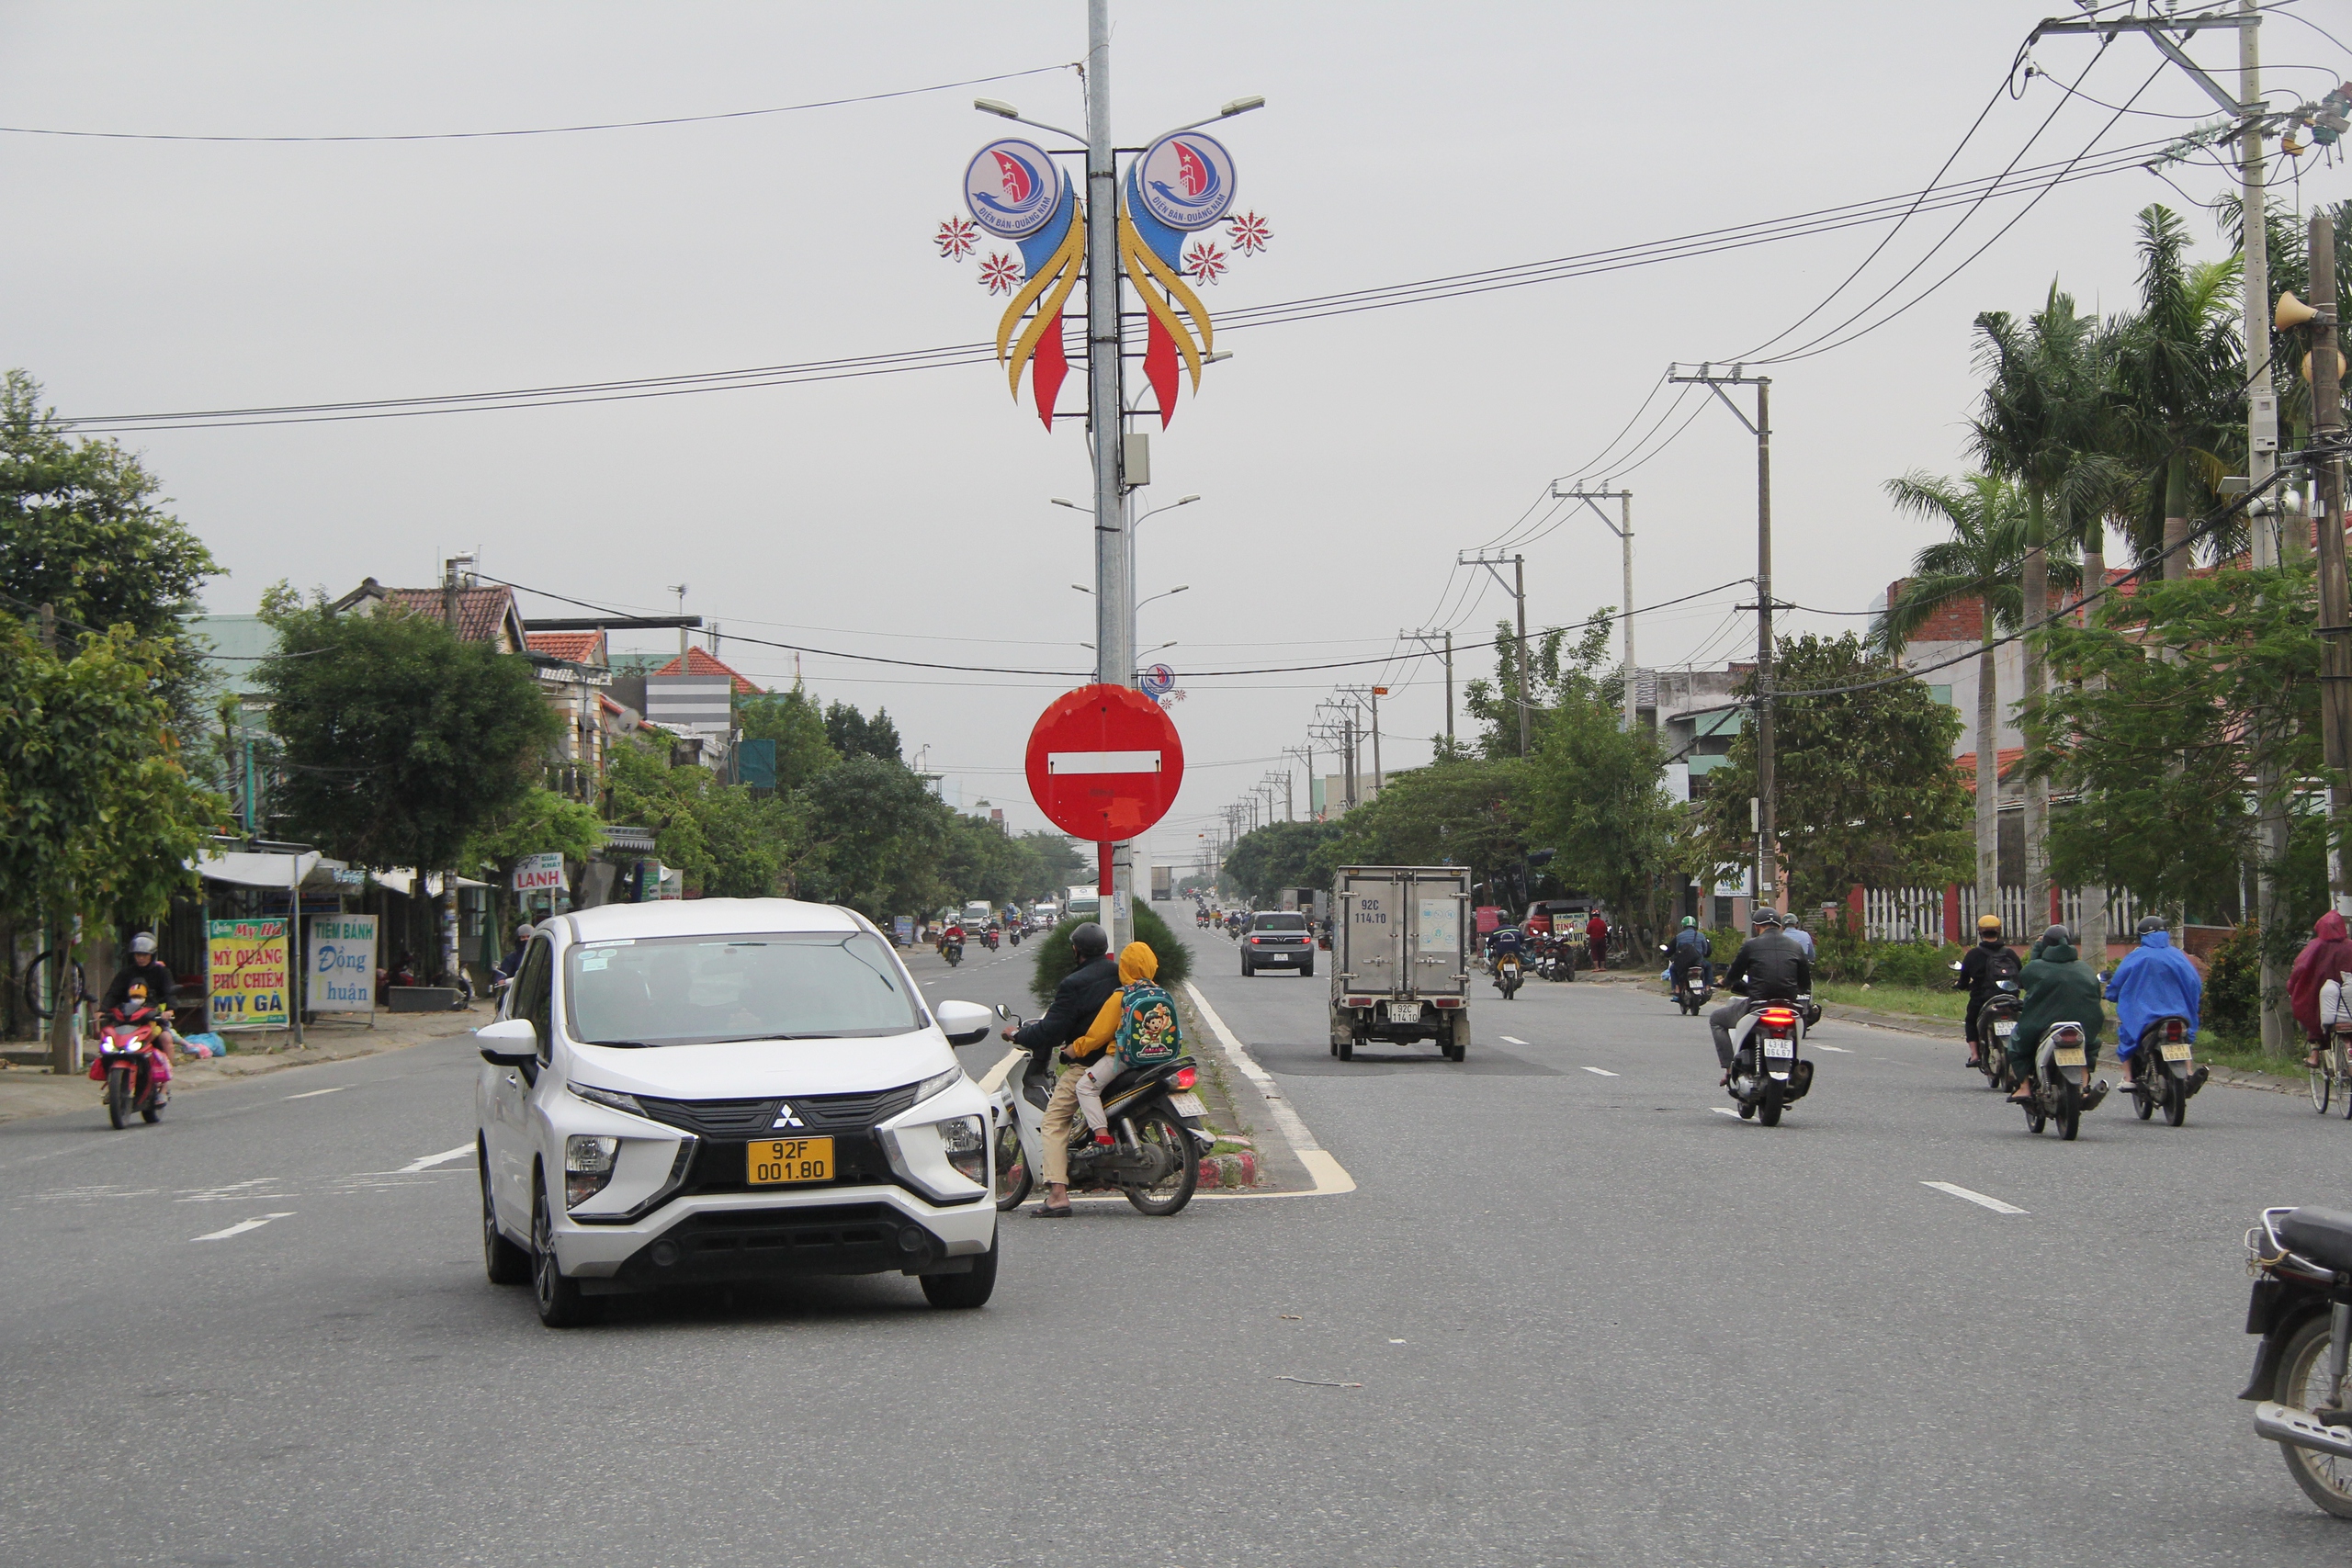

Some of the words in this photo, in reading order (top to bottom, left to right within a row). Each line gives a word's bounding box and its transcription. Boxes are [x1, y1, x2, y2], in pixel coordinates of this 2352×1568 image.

[1036, 197, 1051, 215] NAM
[1213, 193, 1227, 211] NAM
[517, 871, 559, 888] LANH
[1362, 899, 1379, 910] 92C
[1355, 912, 1386, 924] 114.10
[314, 918, 341, 943] TIỆM
[343, 918, 374, 940] BÁNH
[318, 945, 367, 973] Đồng
[254, 990, 283, 1011] GÀ
[1397, 1004, 1412, 1013] 92C
[1393, 1013, 1418, 1022] 114.10
[1766, 1048, 1791, 1057] 064.67
[772, 1141, 808, 1160] 92F
[757, 1160, 824, 1181] 001.80
